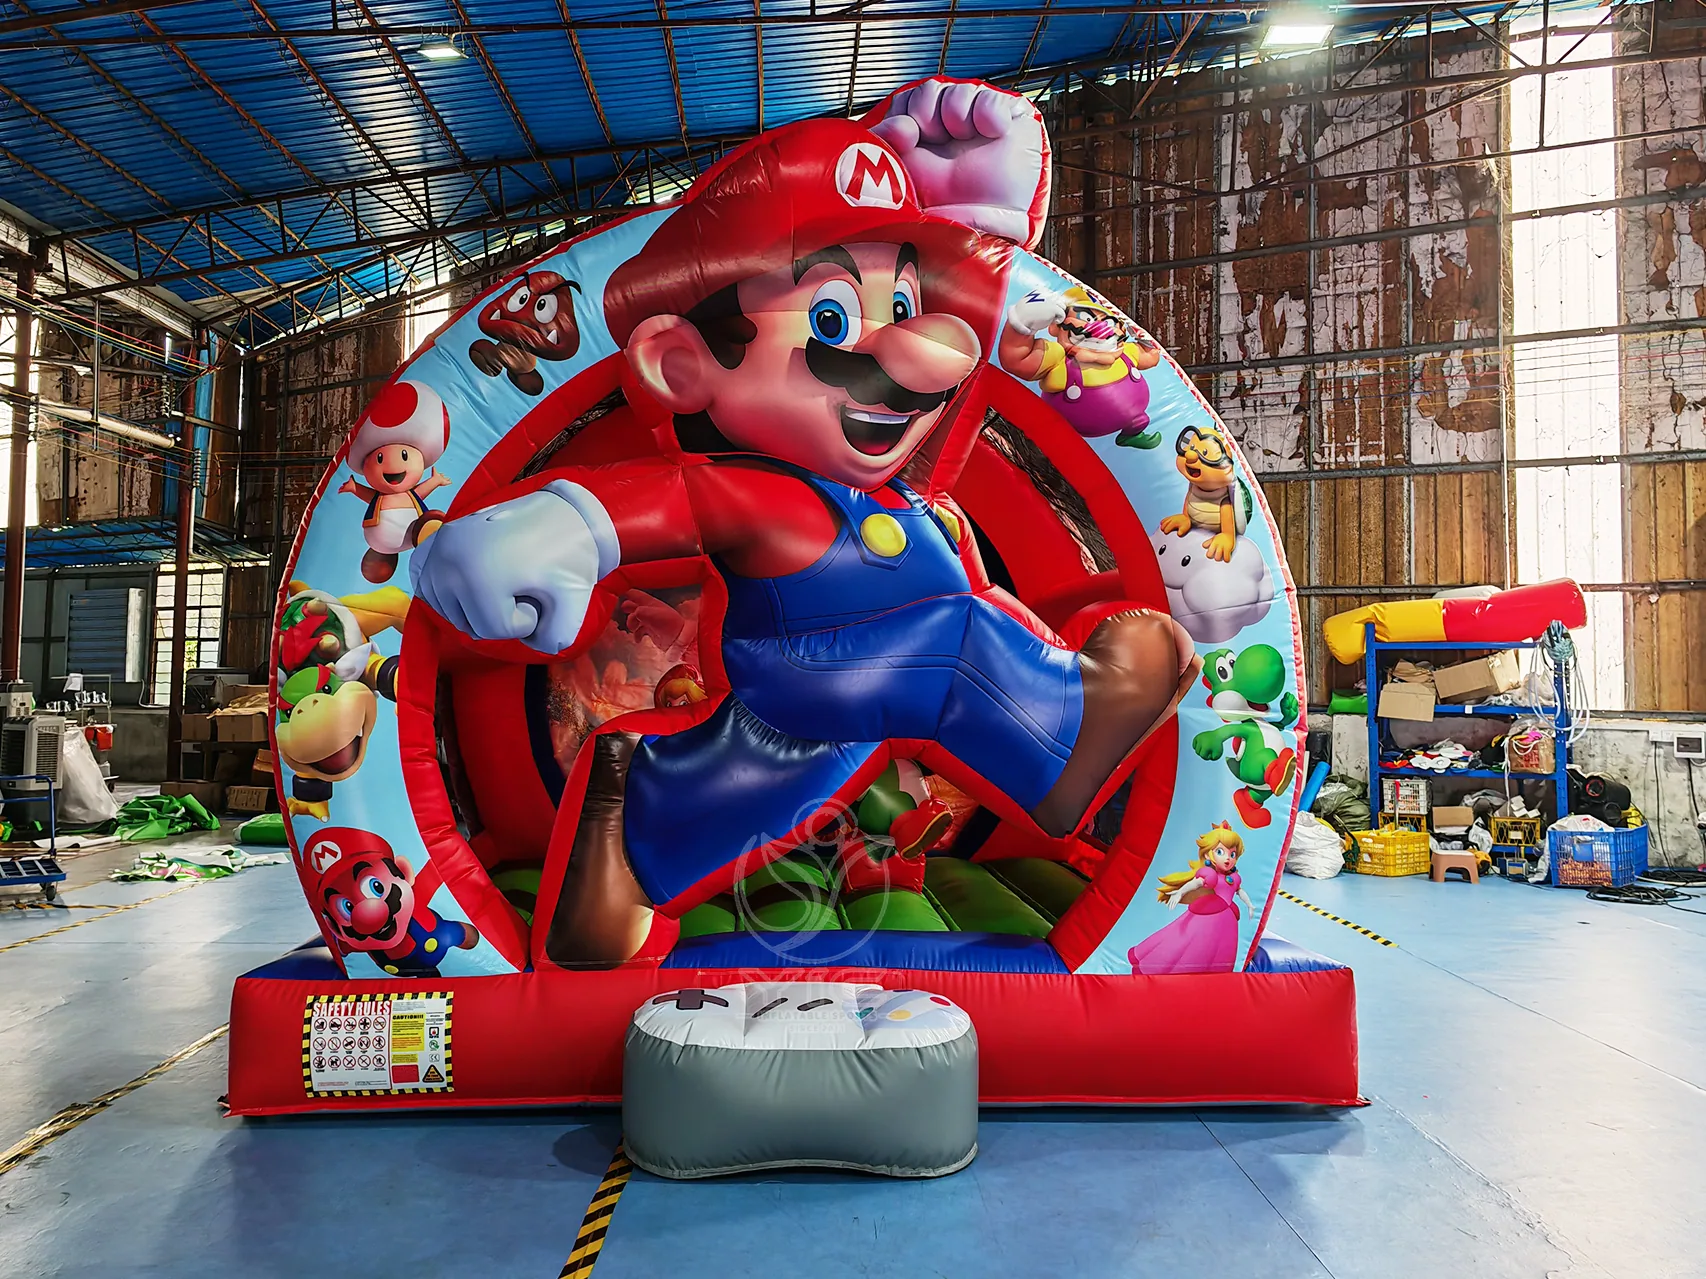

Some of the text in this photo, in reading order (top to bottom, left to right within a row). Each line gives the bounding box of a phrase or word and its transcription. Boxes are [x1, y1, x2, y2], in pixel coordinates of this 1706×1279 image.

[845, 148, 904, 205] M
[314, 844, 339, 870] M
[312, 1001, 355, 1017] SAFETY
[356, 1000, 391, 1016] RULES
